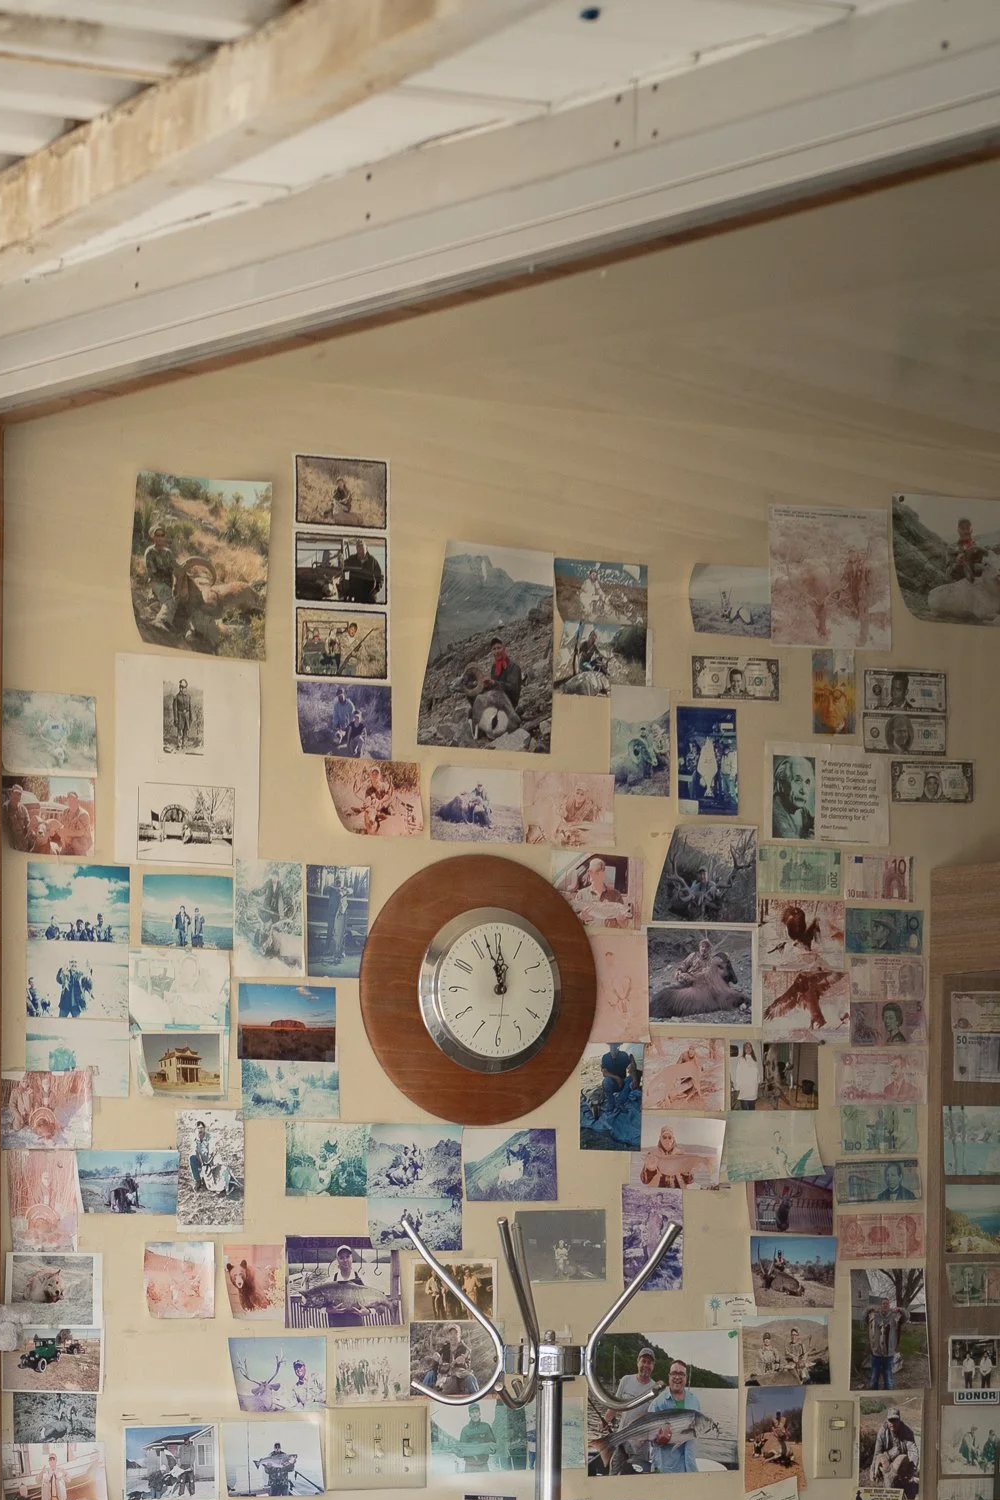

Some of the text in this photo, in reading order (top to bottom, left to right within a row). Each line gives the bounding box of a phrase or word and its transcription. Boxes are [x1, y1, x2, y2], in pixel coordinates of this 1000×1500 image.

[892, 858, 907, 875] 10
[829, 871, 838, 889] 200
[847, 889, 856, 898] 10
[904, 913, 920, 931] 10
[471, 939, 485, 960] 11
[513, 940, 523, 960] 1
[453, 958, 473, 975] 10
[524, 961, 541, 975] 2
[448, 985, 469, 993] 9
[455, 1005, 473, 1020] 8
[525, 1007, 541, 1020] 4
[472, 1019, 486, 1039] 7
[495, 1025, 502, 1047] 6
[512, 1019, 522, 1041] 5
[956, 1035, 968, 1045] 50
[958, 1391, 996, 1400] DONOR
